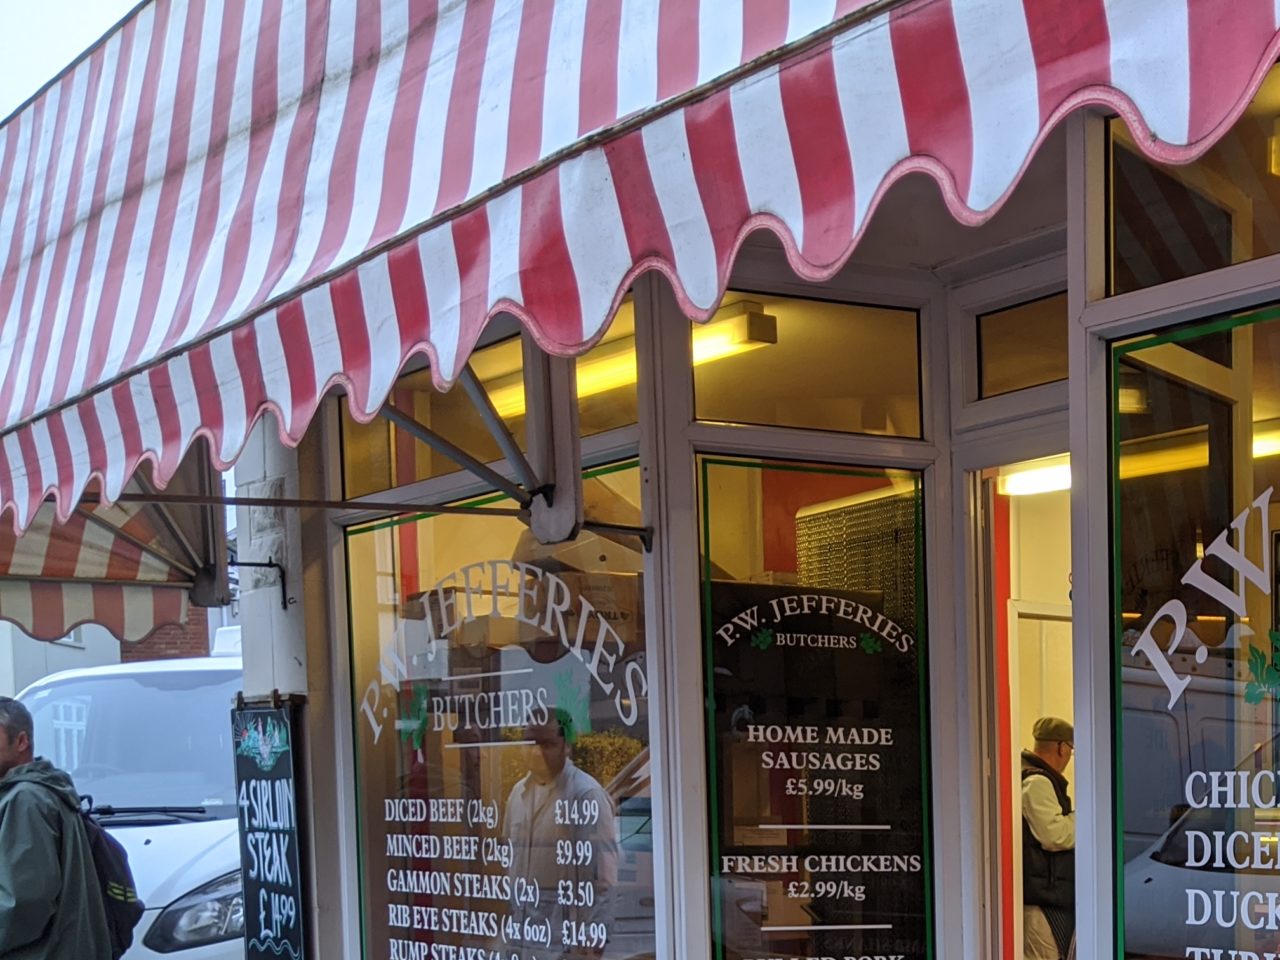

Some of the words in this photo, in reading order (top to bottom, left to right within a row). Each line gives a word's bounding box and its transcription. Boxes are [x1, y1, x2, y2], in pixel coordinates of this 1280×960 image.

[716, 605, 766, 647] P.W.
[769, 594, 915, 653] JEFFERIES
[419, 560, 648, 727] JEFFERIES
[776, 633, 857, 649] BUTCHERS
[432, 688, 549, 731] BUTCHERS
[747, 725, 819, 744] HOME
[825, 727, 894, 746] MADE
[761, 751, 881, 771] SAUSAGES
[249, 778, 295, 832] SIRLOIN
[785, 778, 864, 800] £5.99/kg
[385, 798, 427, 822] DICED
[429, 799, 464, 822] BEEF
[467, 799, 498, 829] (2kg)
[555, 800, 599, 825] £14.99
[247, 831, 292, 887] STEAK
[386, 834, 440, 857] MINCED
[443, 836, 479, 860] BEEF
[482, 837, 514, 868] (2kg)
[556, 840, 593, 866] £9.99
[721, 855, 799, 873] FRESH
[804, 855, 922, 873] CHICKENS
[387, 868, 450, 897] GAMMON
[454, 873, 511, 900] STEAKS
[514, 877, 540, 908] (2x)
[558, 880, 594, 907] £3.50
[787, 880, 866, 901] £2.99/kg
[388, 904, 410, 928] RIB
[413, 906, 439, 931] EYE
[442, 908, 498, 937] STEAKS
[501, 915, 521, 944] (4x
[524, 917, 551, 948] 6oz)
[562, 920, 607, 949] £14.99
